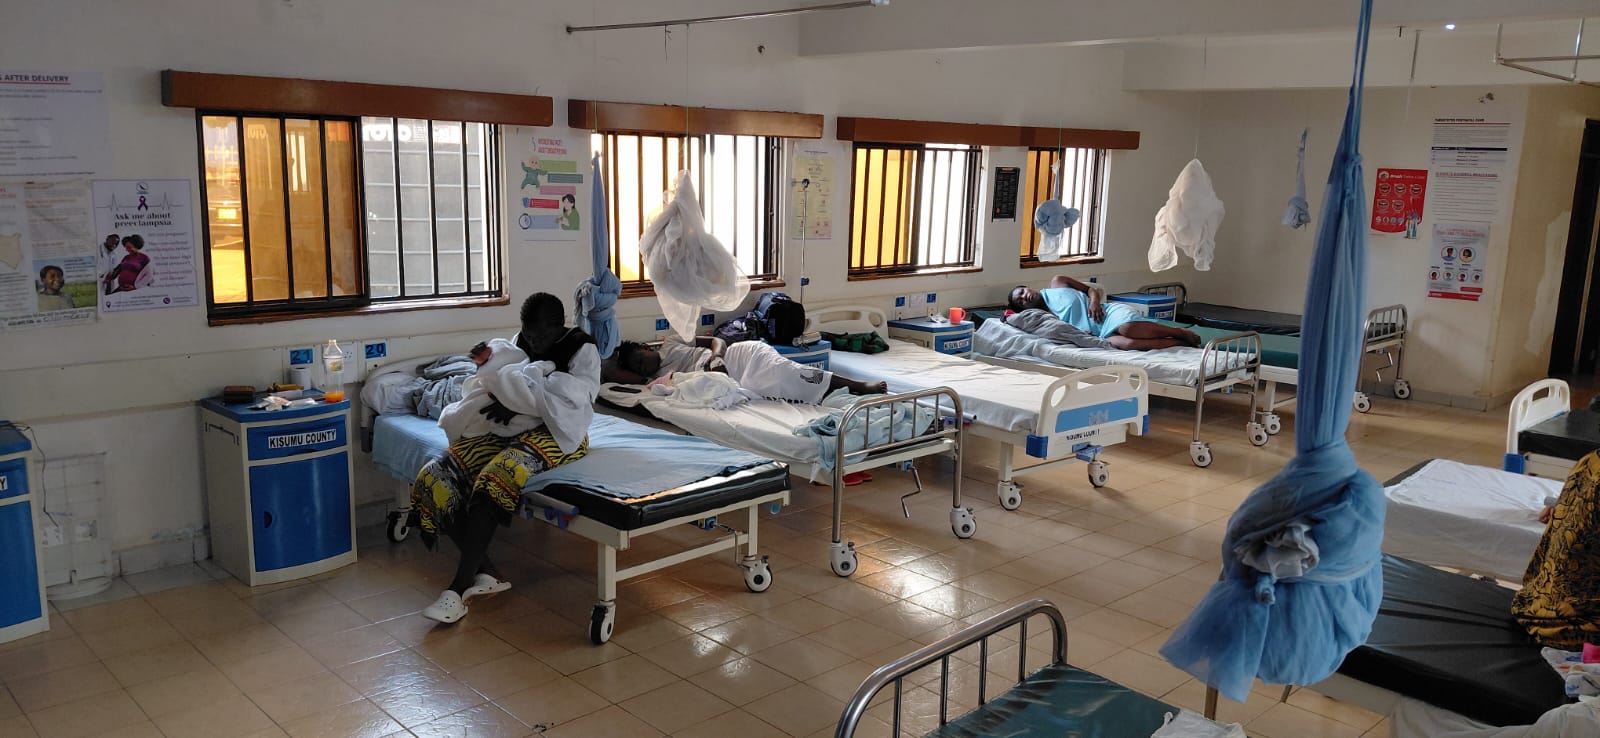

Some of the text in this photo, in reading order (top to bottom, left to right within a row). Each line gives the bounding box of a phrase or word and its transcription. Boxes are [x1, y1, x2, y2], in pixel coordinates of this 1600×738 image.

[114, 219, 172, 228] preeclampsia
[366, 344, 385, 355] 20
[292, 350, 310, 361] 21
[270, 430, 336, 447] KISUMU COUNTY
